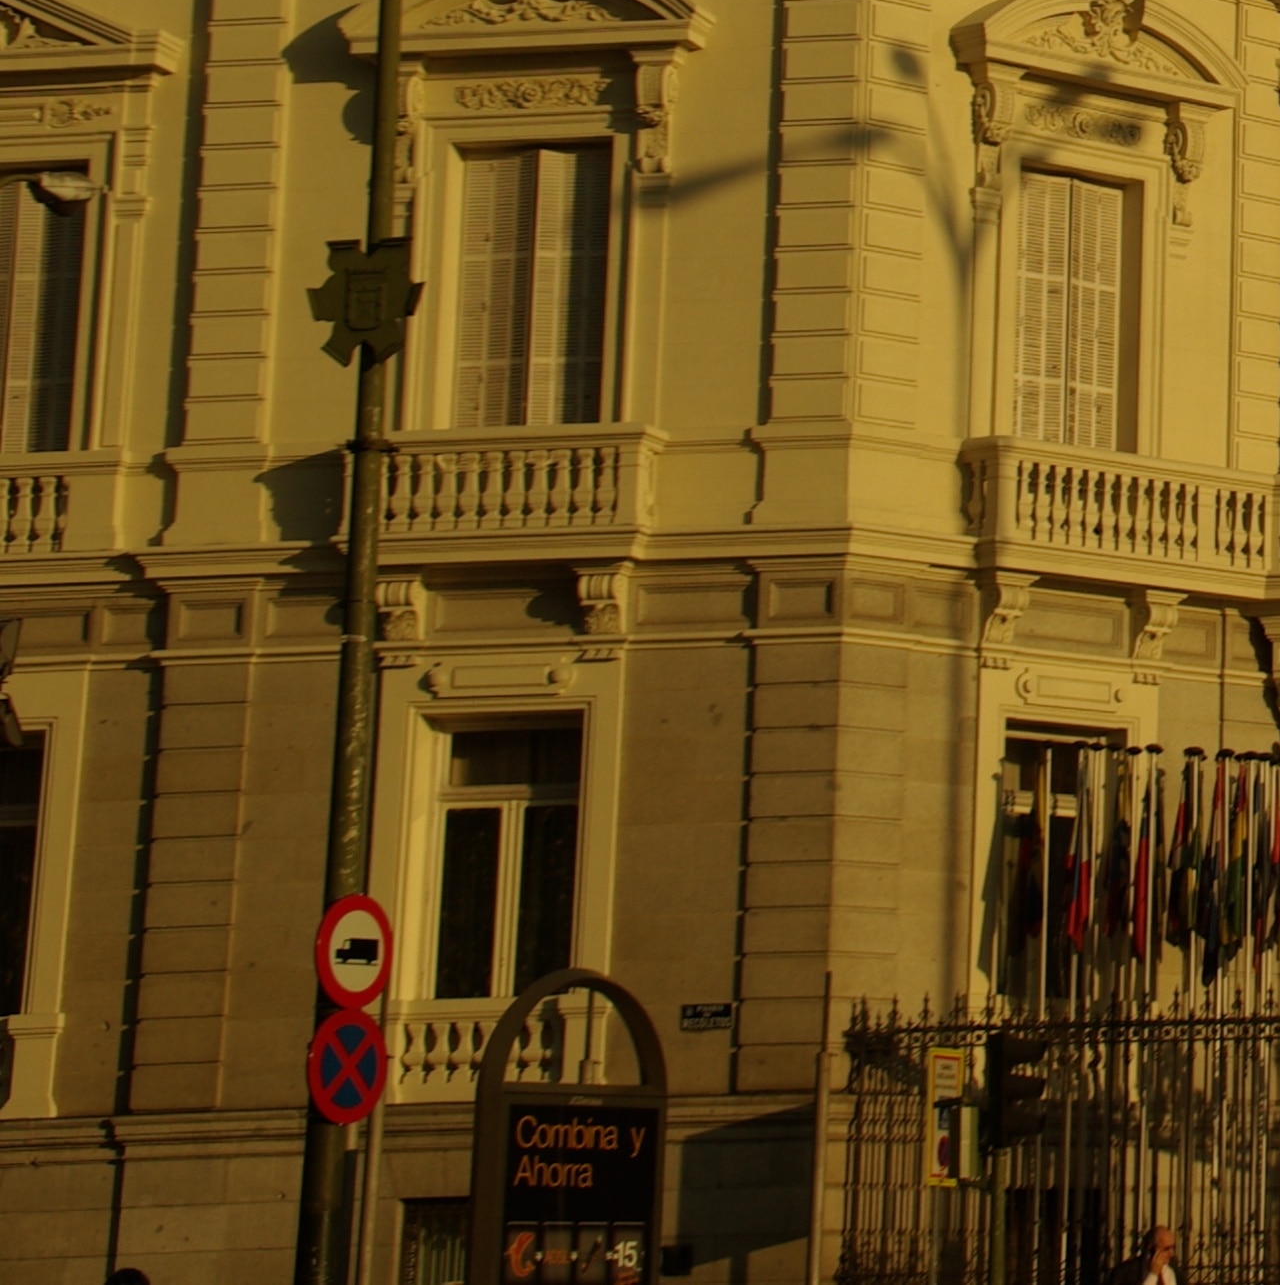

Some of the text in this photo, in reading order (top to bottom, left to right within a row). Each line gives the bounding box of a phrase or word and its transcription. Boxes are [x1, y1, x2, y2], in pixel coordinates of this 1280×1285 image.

[515, 1114, 647, 1159] Combina y
[512, 1154, 594, 1189] Ahorra
